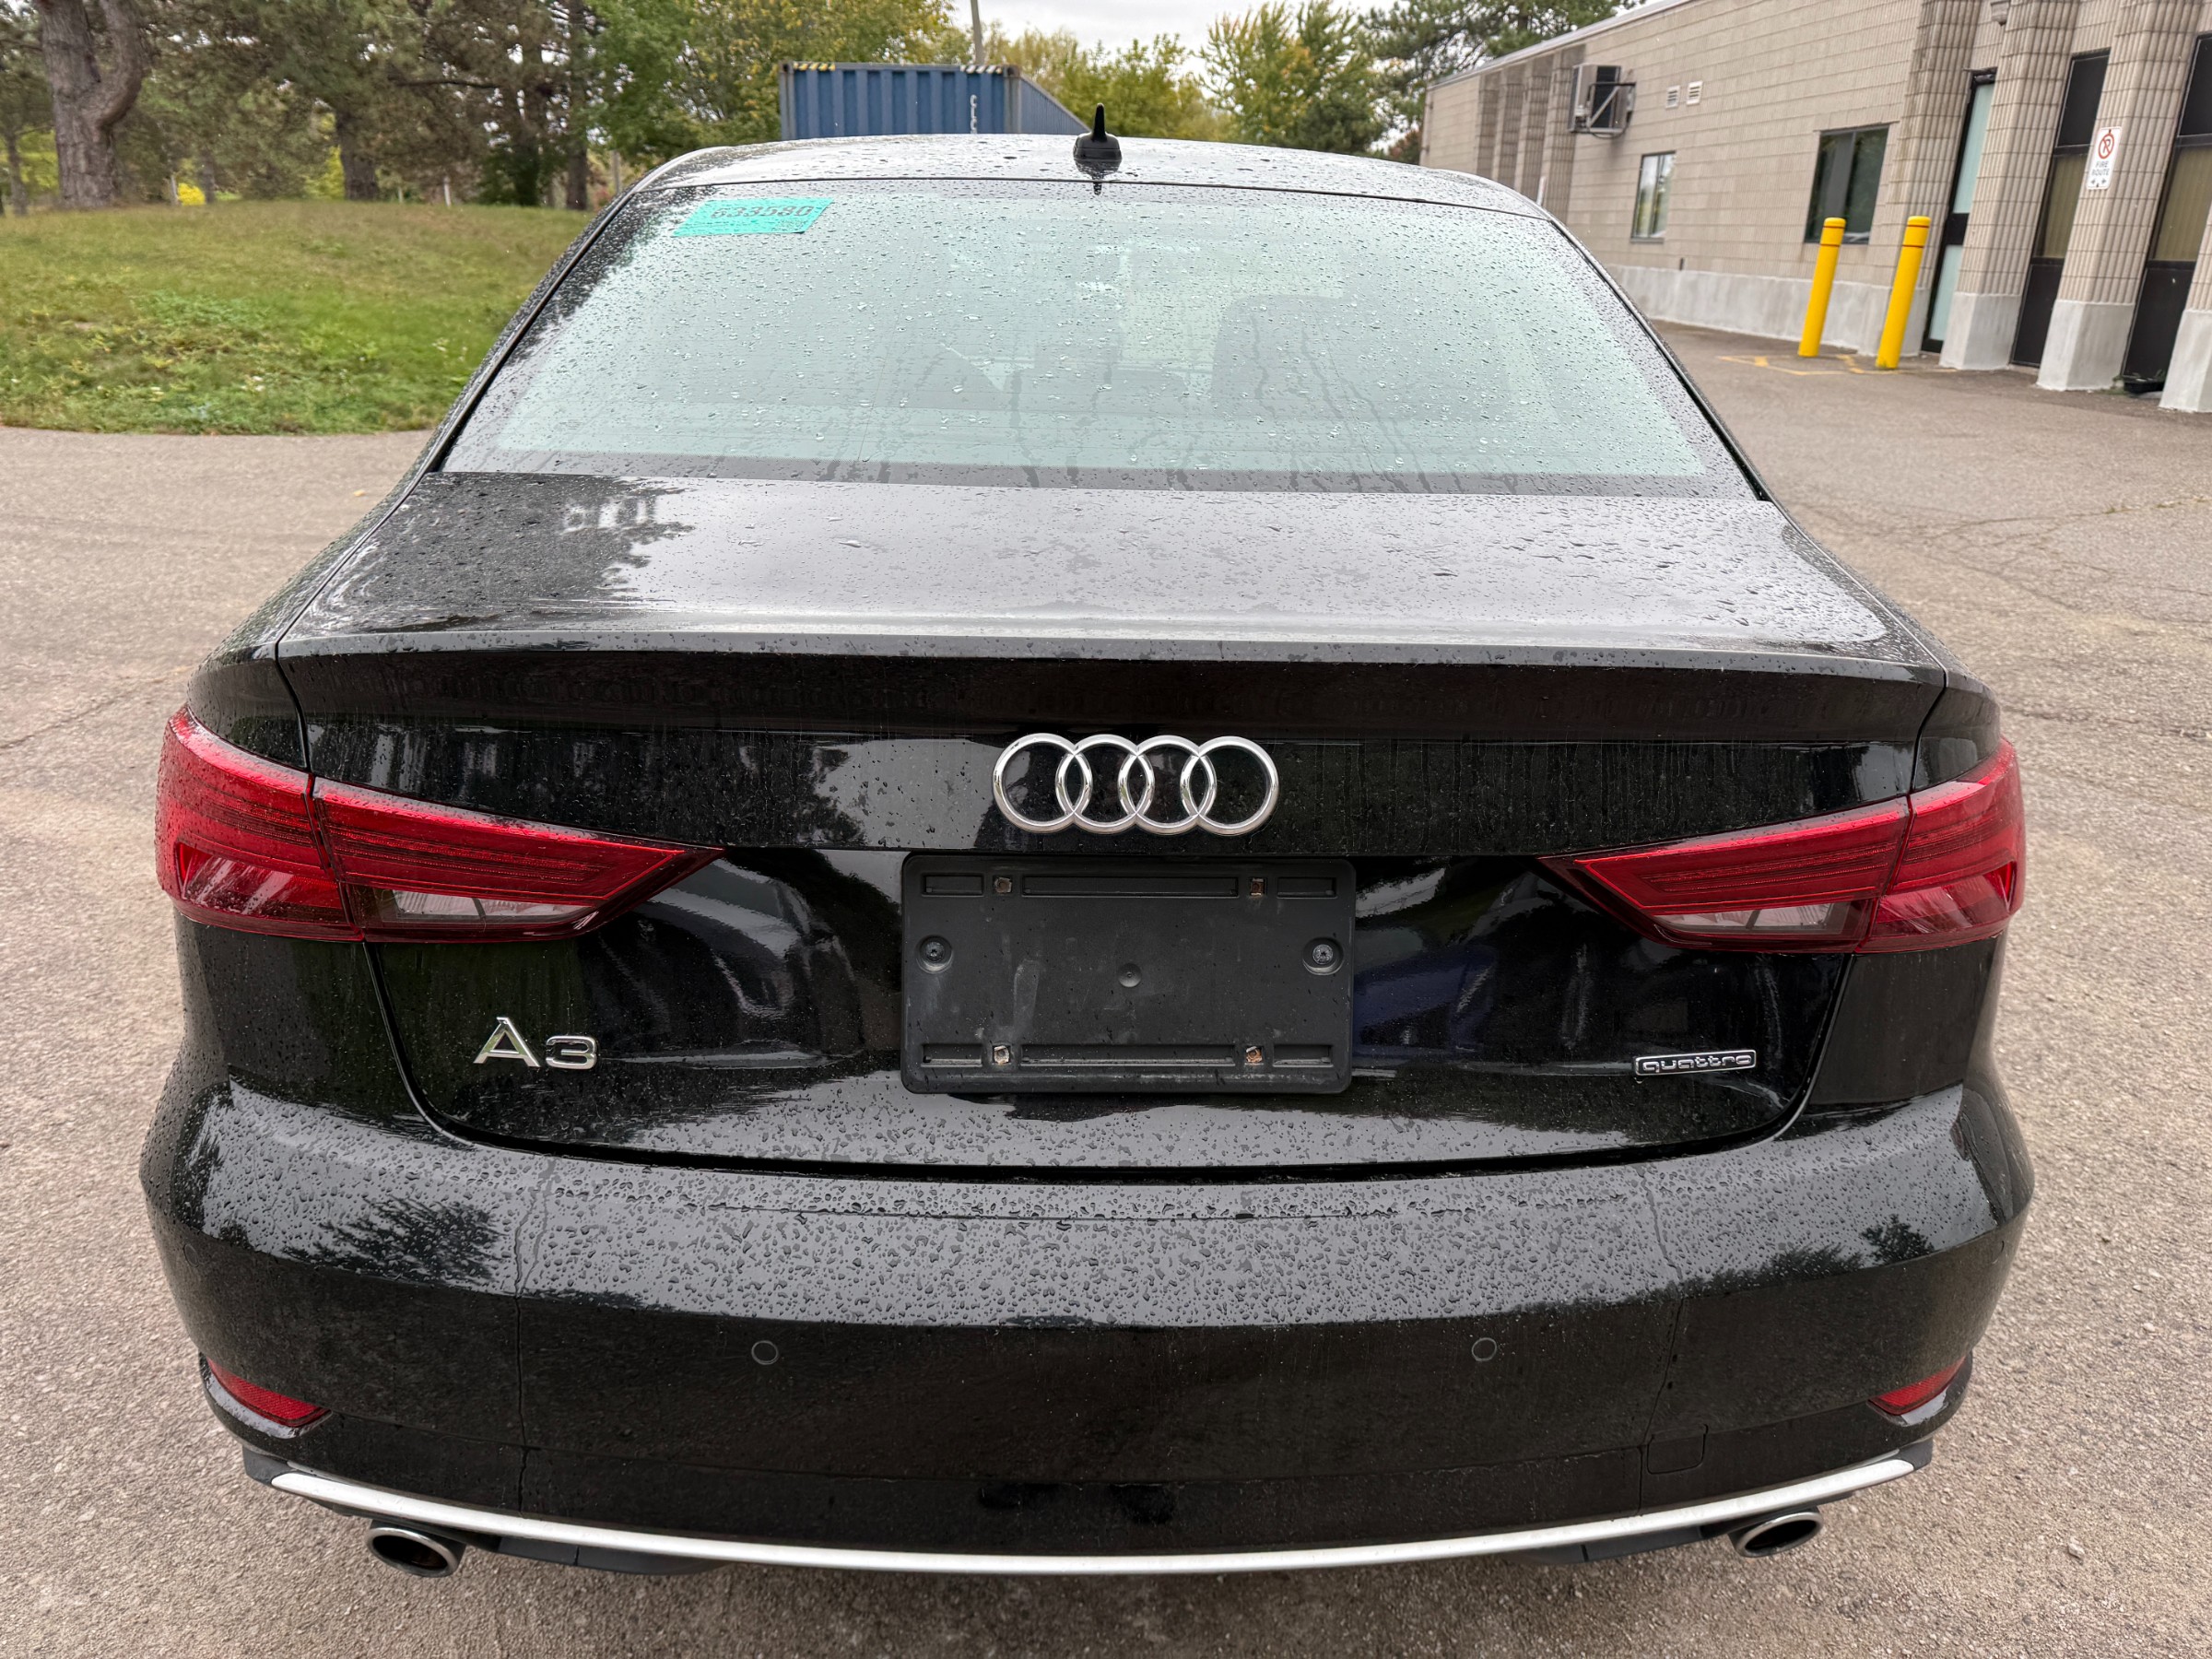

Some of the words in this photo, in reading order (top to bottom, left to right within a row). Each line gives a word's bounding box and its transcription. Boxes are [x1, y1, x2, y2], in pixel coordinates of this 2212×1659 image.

[2091, 168, 2110, 176] ROUTE
[711, 205, 815, 219] 633580
[473, 1016, 597, 1070] A3
[1642, 1055, 1752, 1073] quattro
